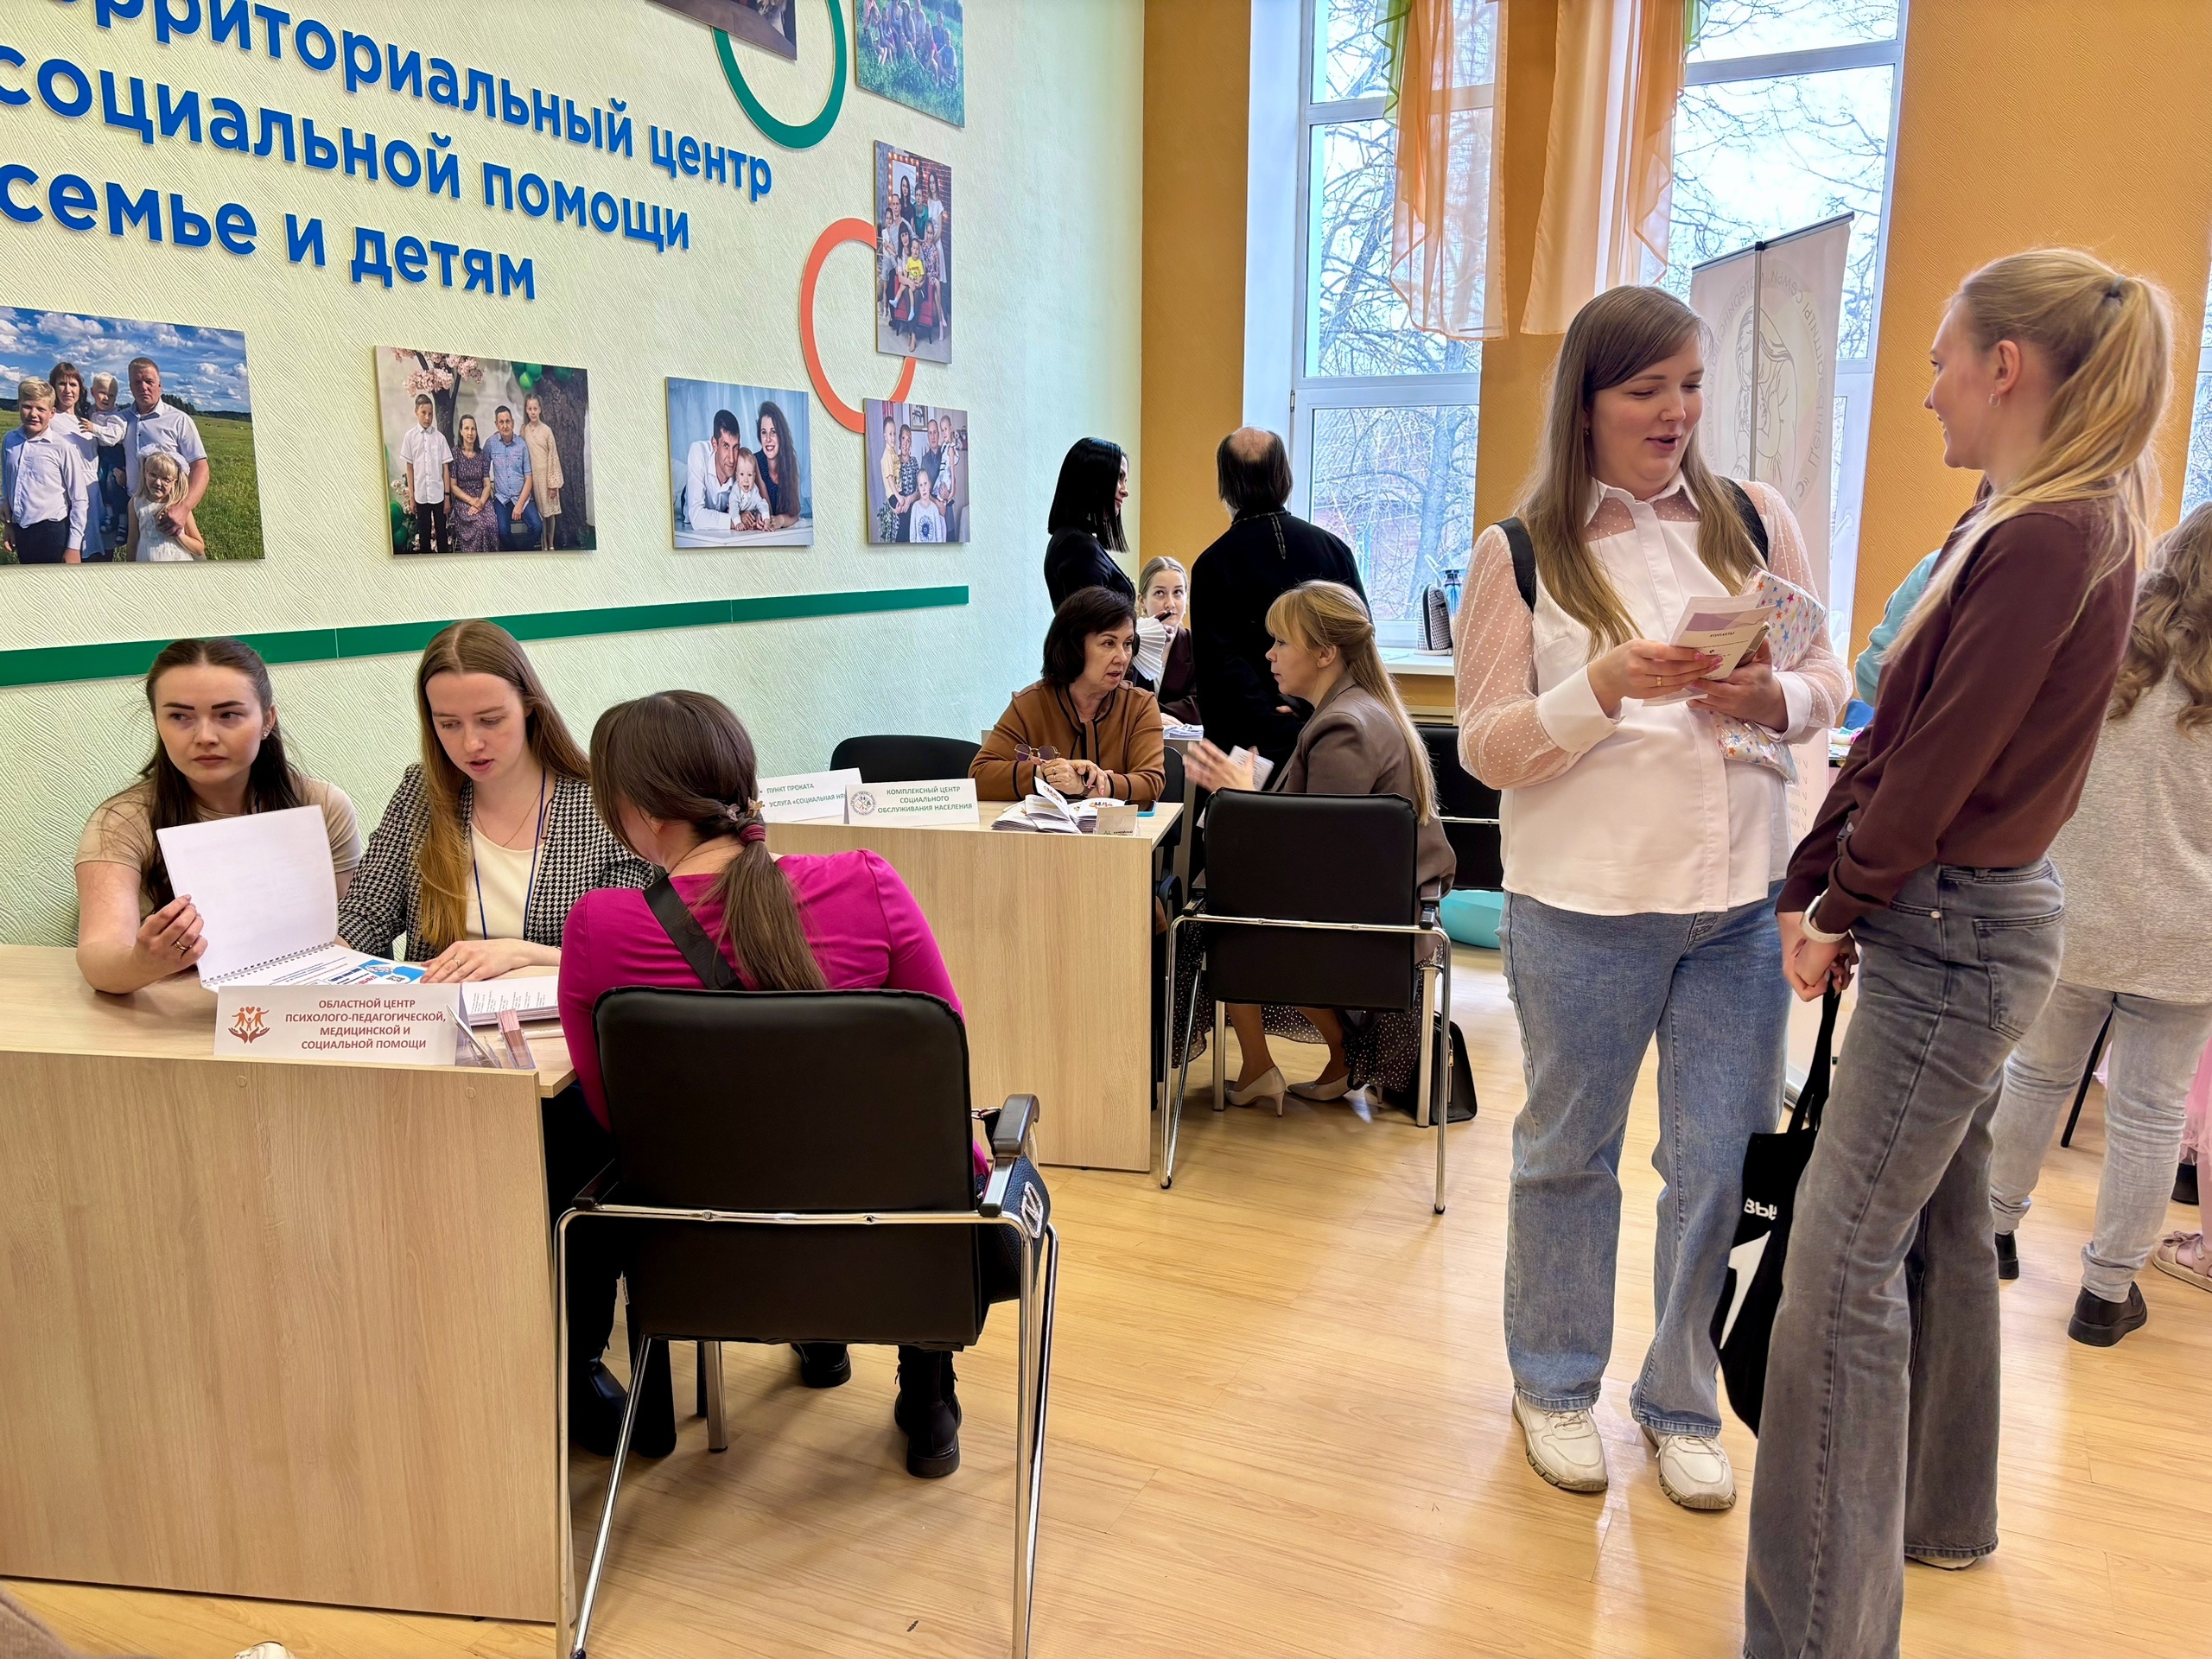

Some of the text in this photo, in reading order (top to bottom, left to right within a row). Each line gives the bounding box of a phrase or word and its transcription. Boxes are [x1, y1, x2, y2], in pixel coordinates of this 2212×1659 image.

[52, 0, 772, 202] риториальный центр
[0, 45, 689, 251] социальной помощи
[0, 164, 536, 301] семье и детям
[766, 783, 814, 794] ПУНКТ ПРОКАТА
[887, 786, 938, 795] КОМПЛЕКСНЫЙ
[792, 794, 835, 804] «СОЦИАЛЬНАЯ
[899, 795, 950, 804] СОЦИАЛЬНОГО
[877, 804, 933, 813] ОБСЛУЖИВАНИЯ
[319, 998, 416, 1009] ОБЛАСТНОЙ ЦЕНТР
[285, 1011, 447, 1023] ПСИХОЛОГО-ПЕДАГОГИЧЕСКОЙ,
[320, 1025, 410, 1037] МЕДИЦИНСКОЙ И
[302, 1039, 427, 1051] СОЦИАЛЬНОЙ ПОМОЩИ
